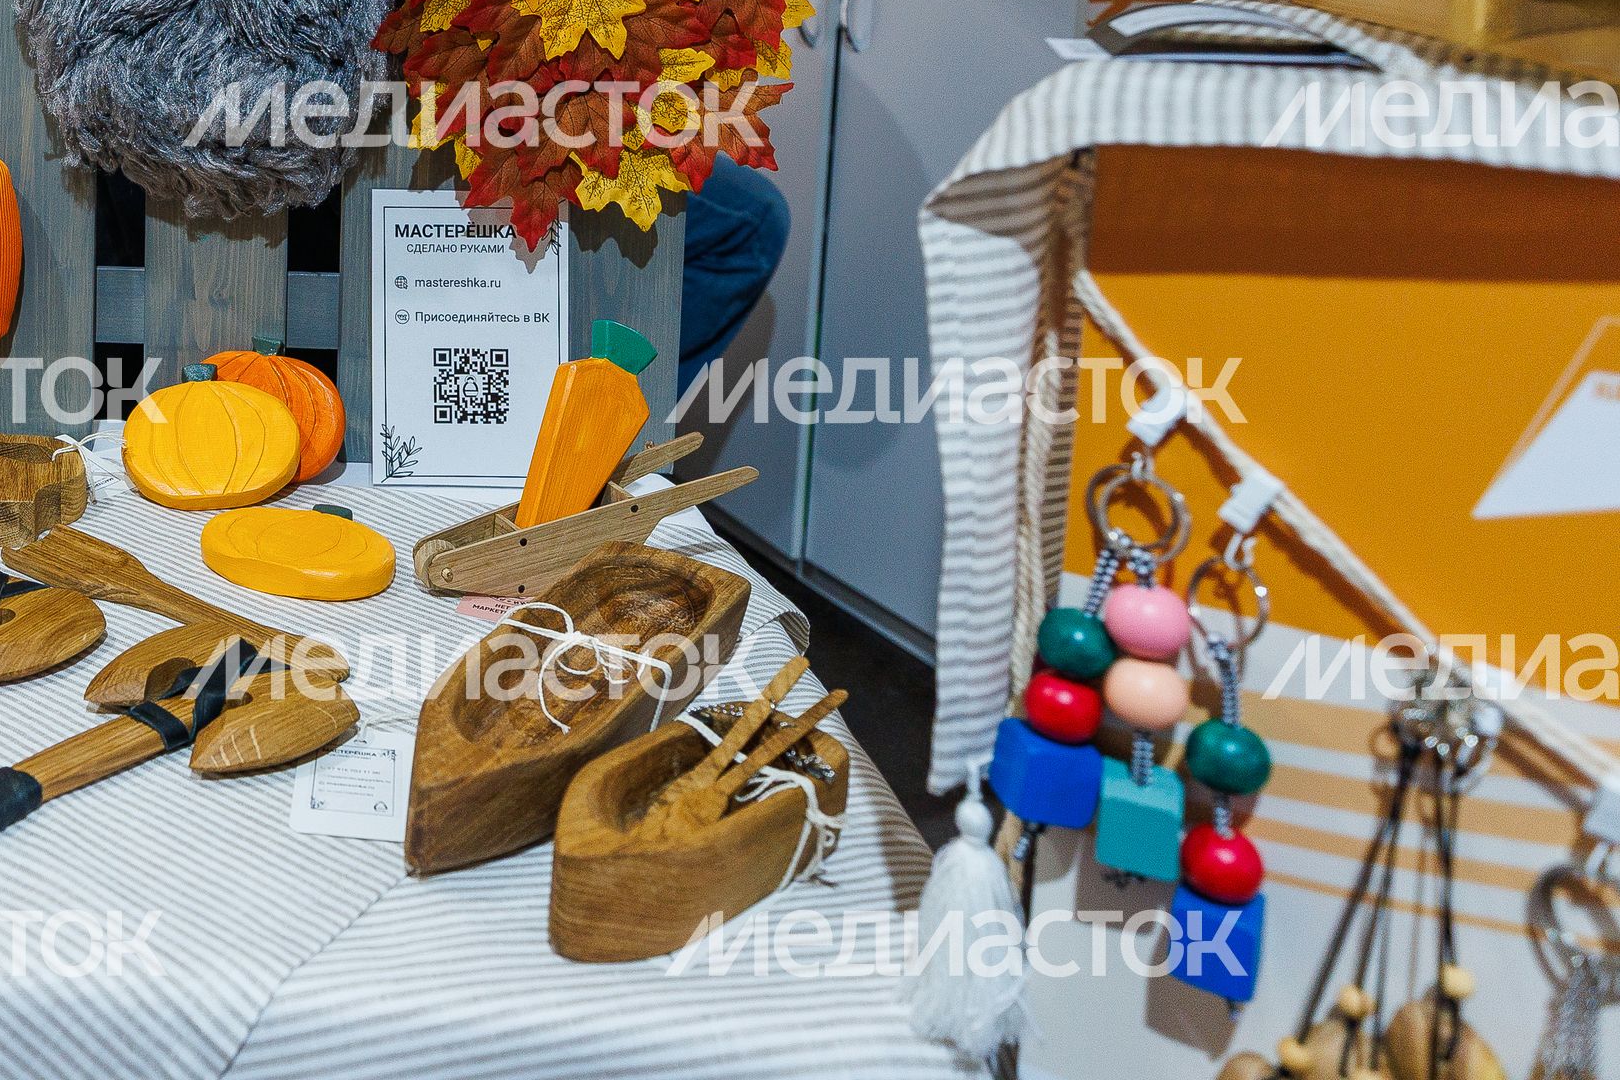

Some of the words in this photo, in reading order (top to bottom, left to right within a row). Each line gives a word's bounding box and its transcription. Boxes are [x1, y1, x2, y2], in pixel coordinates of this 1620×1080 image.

[394, 221, 517, 239] МАСТЕРЁШКА
[406, 243, 458, 255] СДЕЛАНО
[460, 243, 505, 254] РУКАМИ
[414, 276, 502, 289] mastereshka.ru
[414, 311, 520, 324] Присоединяйтесь
[533, 312, 550, 323] ВК
